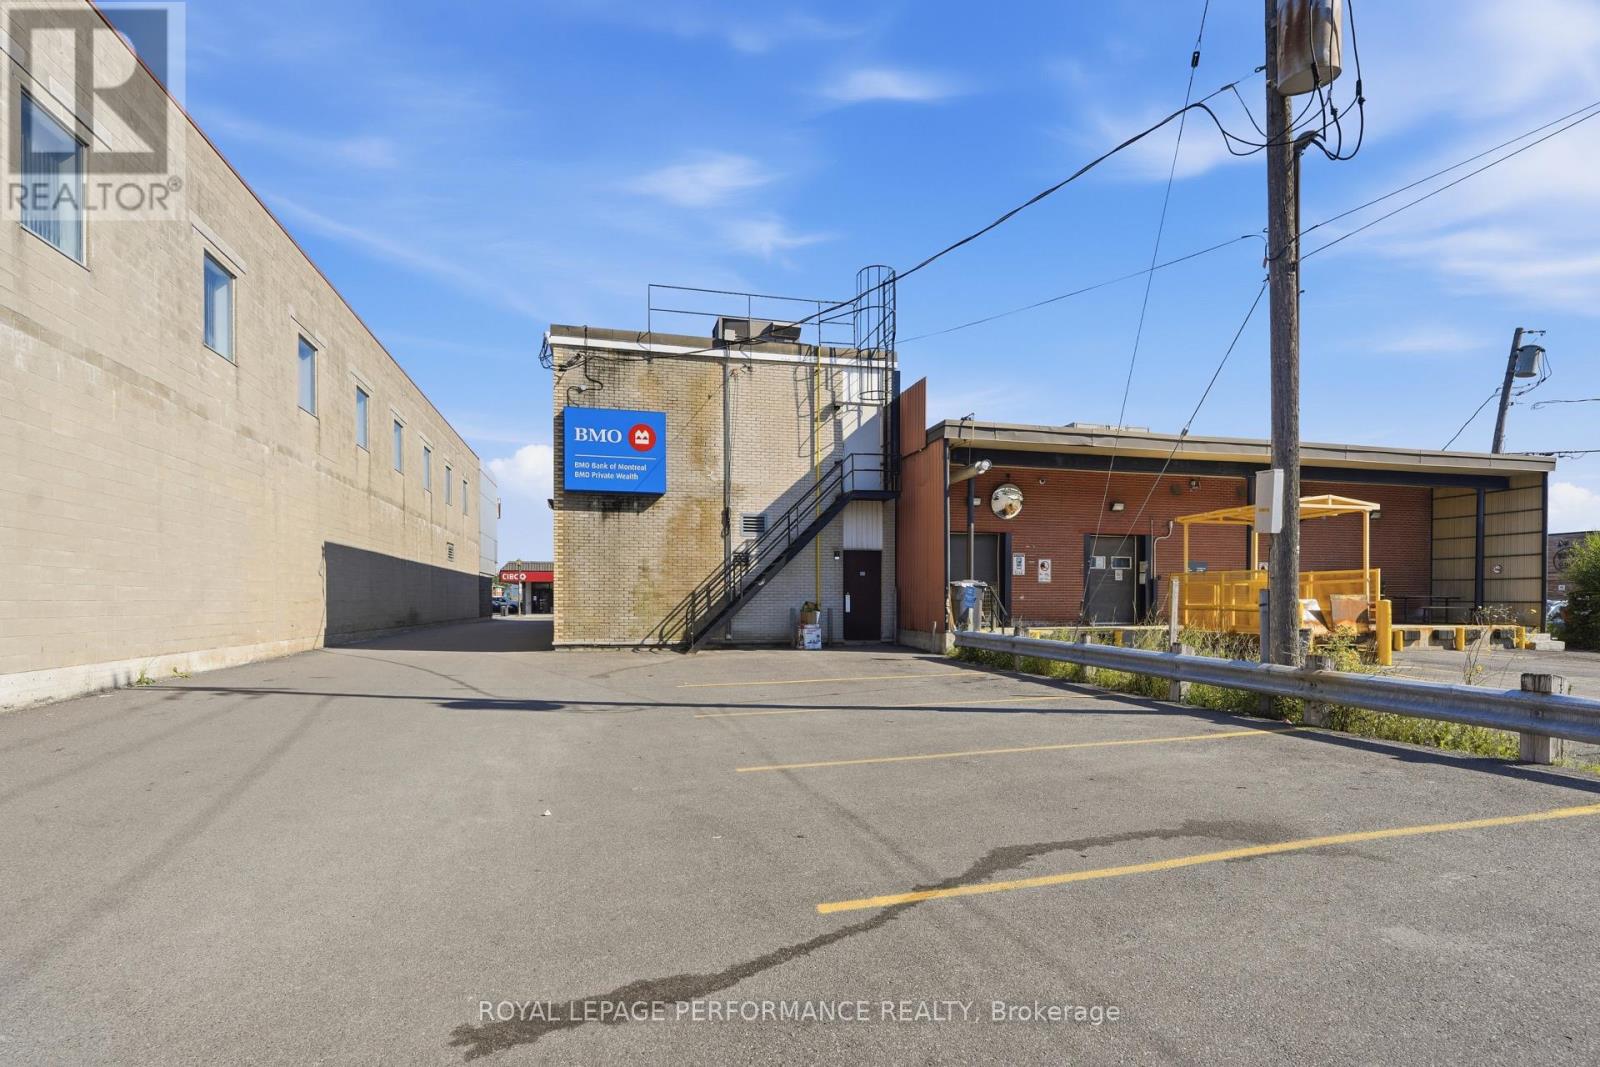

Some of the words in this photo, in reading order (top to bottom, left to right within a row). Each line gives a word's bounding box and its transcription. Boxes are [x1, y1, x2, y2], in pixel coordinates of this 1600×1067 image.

[575, 427, 622, 443] BMO
[575, 461, 590, 469] BMO
[592, 462, 609, 470] Bank
[618, 463, 647, 471] Montreal
[592, 472, 615, 480] Private
